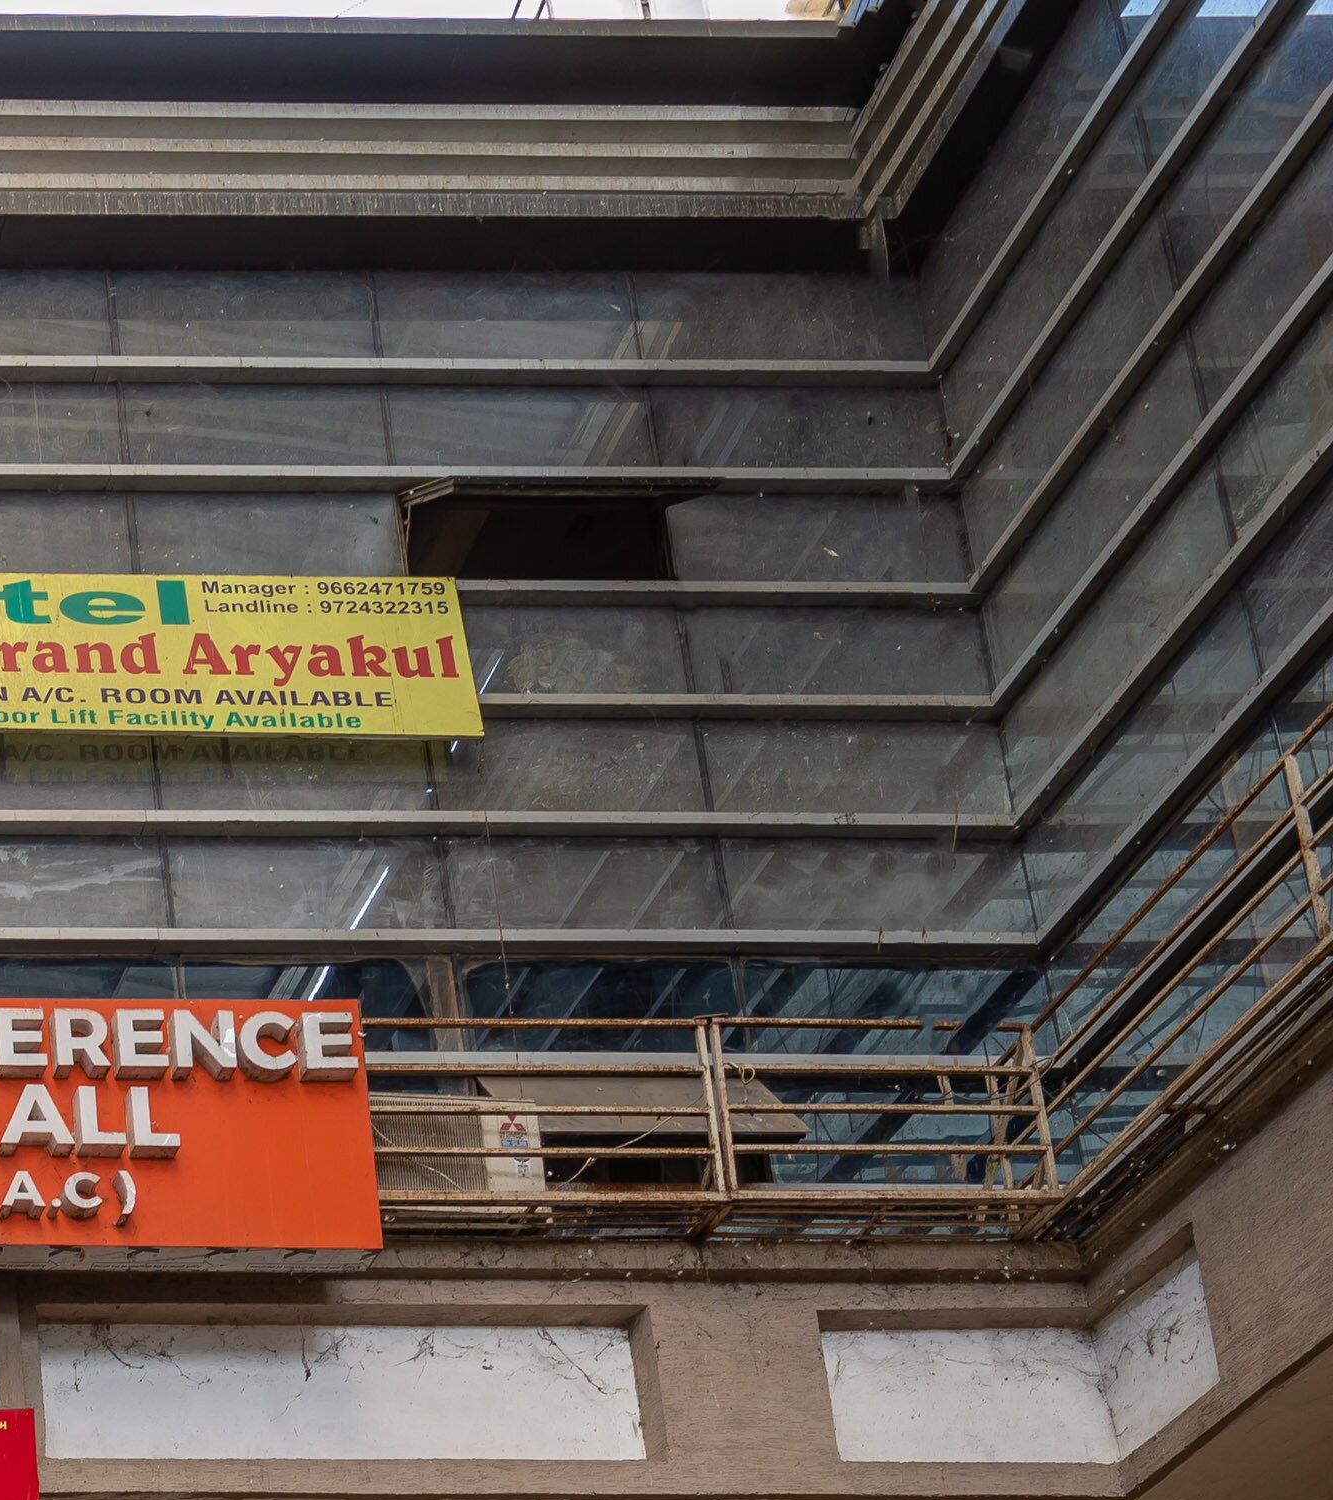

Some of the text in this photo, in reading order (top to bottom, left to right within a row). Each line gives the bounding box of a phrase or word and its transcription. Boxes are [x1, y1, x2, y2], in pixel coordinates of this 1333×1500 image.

[201, 580, 447, 598] Manager 9662471759
[205, 599, 450, 615] Landline 9724322315
[182, 633, 461, 687] Aryakul
[21, 686, 87, 705] A/C.
[100, 687, 204, 706] ROOM
[214, 688, 394, 708] AVAILABLE
[50, 708, 98, 727] Lift
[107, 709, 216, 732] Facility
[224, 711, 362, 731] Available
